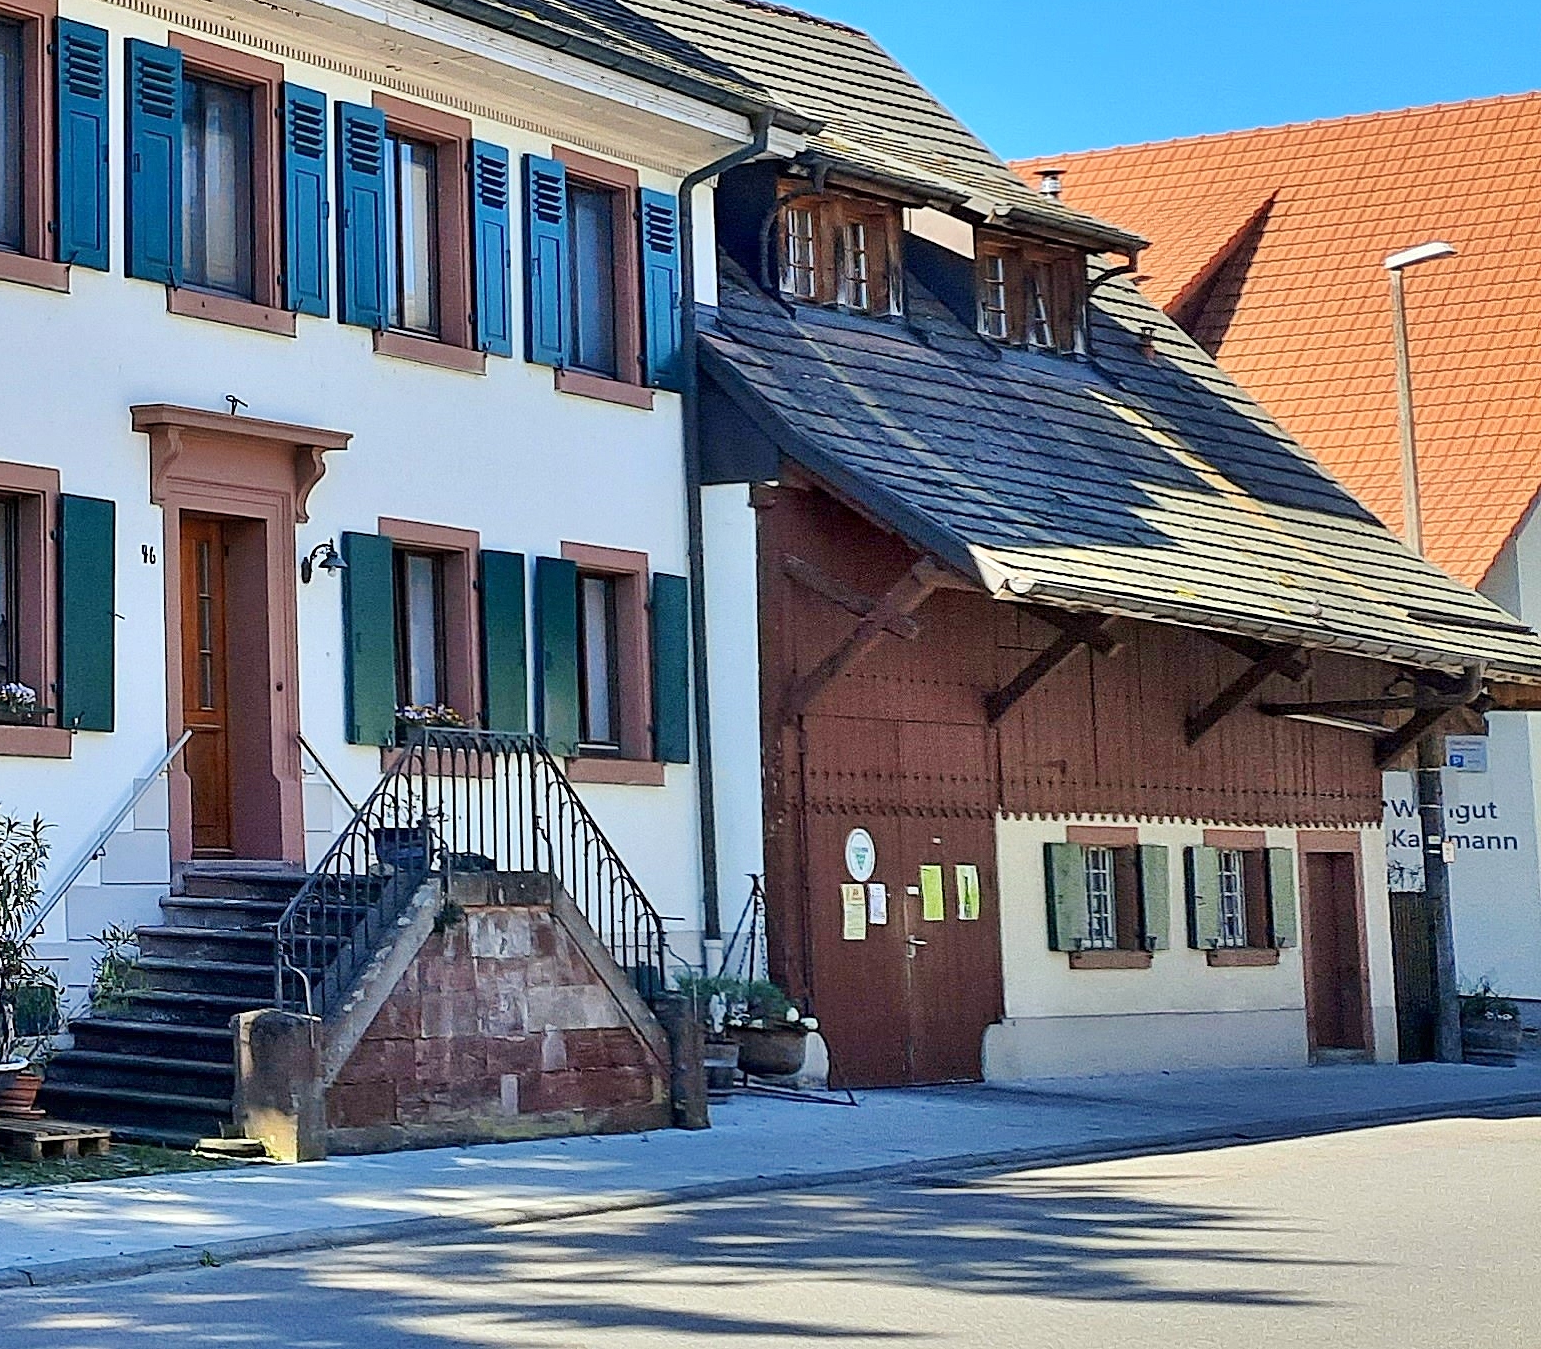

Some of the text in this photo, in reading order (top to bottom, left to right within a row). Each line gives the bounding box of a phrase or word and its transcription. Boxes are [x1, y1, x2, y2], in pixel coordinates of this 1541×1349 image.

[141, 544, 156, 564] 46
[1390, 799, 1498, 824] Wgut
[1391, 829, 1518, 850] Kamann
